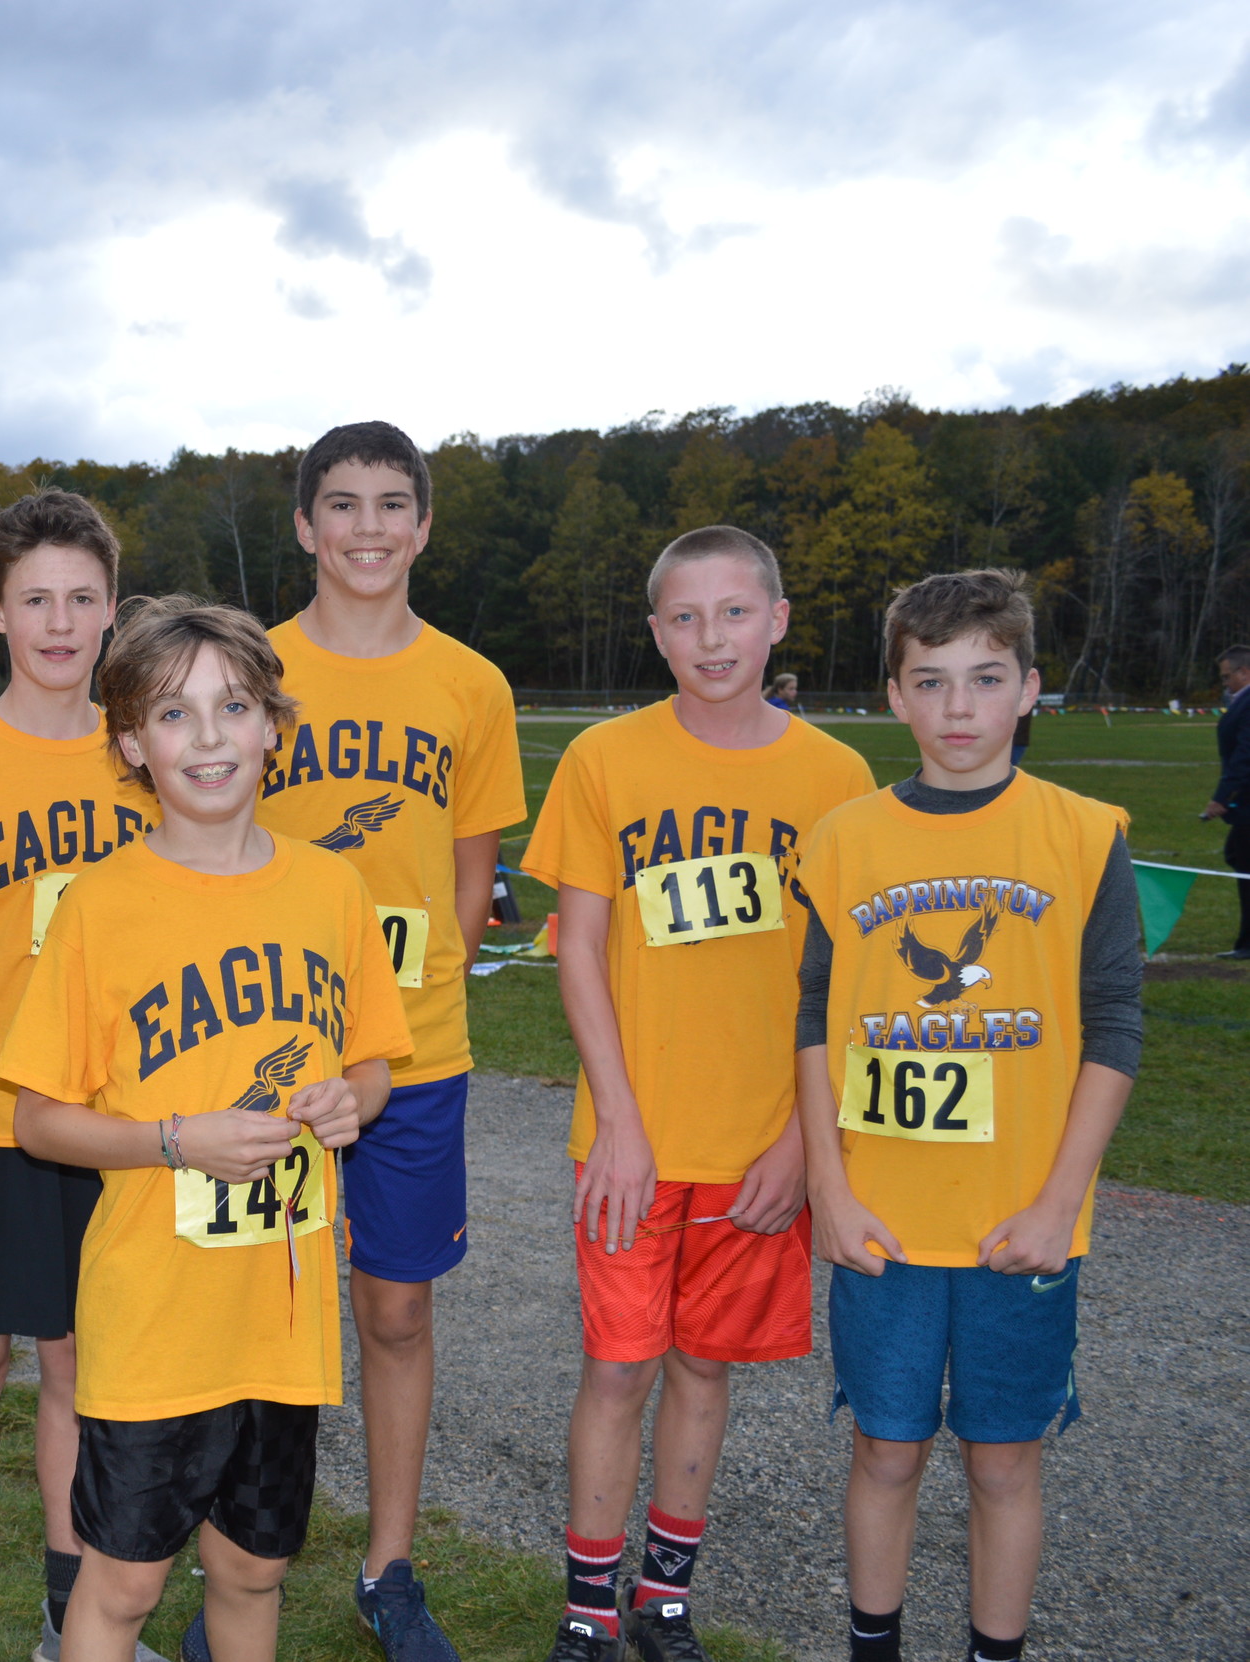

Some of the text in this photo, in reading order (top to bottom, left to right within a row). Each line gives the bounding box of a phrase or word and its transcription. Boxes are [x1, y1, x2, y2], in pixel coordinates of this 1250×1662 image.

[262, 719, 453, 810] EAGLES
[660, 861, 762, 934] 113
[848, 875, 1056, 939] BARRINGTON
[129, 943, 347, 1083] EAGLES
[860, 1008, 1043, 1052] EAGLES
[862, 1057, 968, 1131] 162
[205, 1145, 310, 1235] 142
